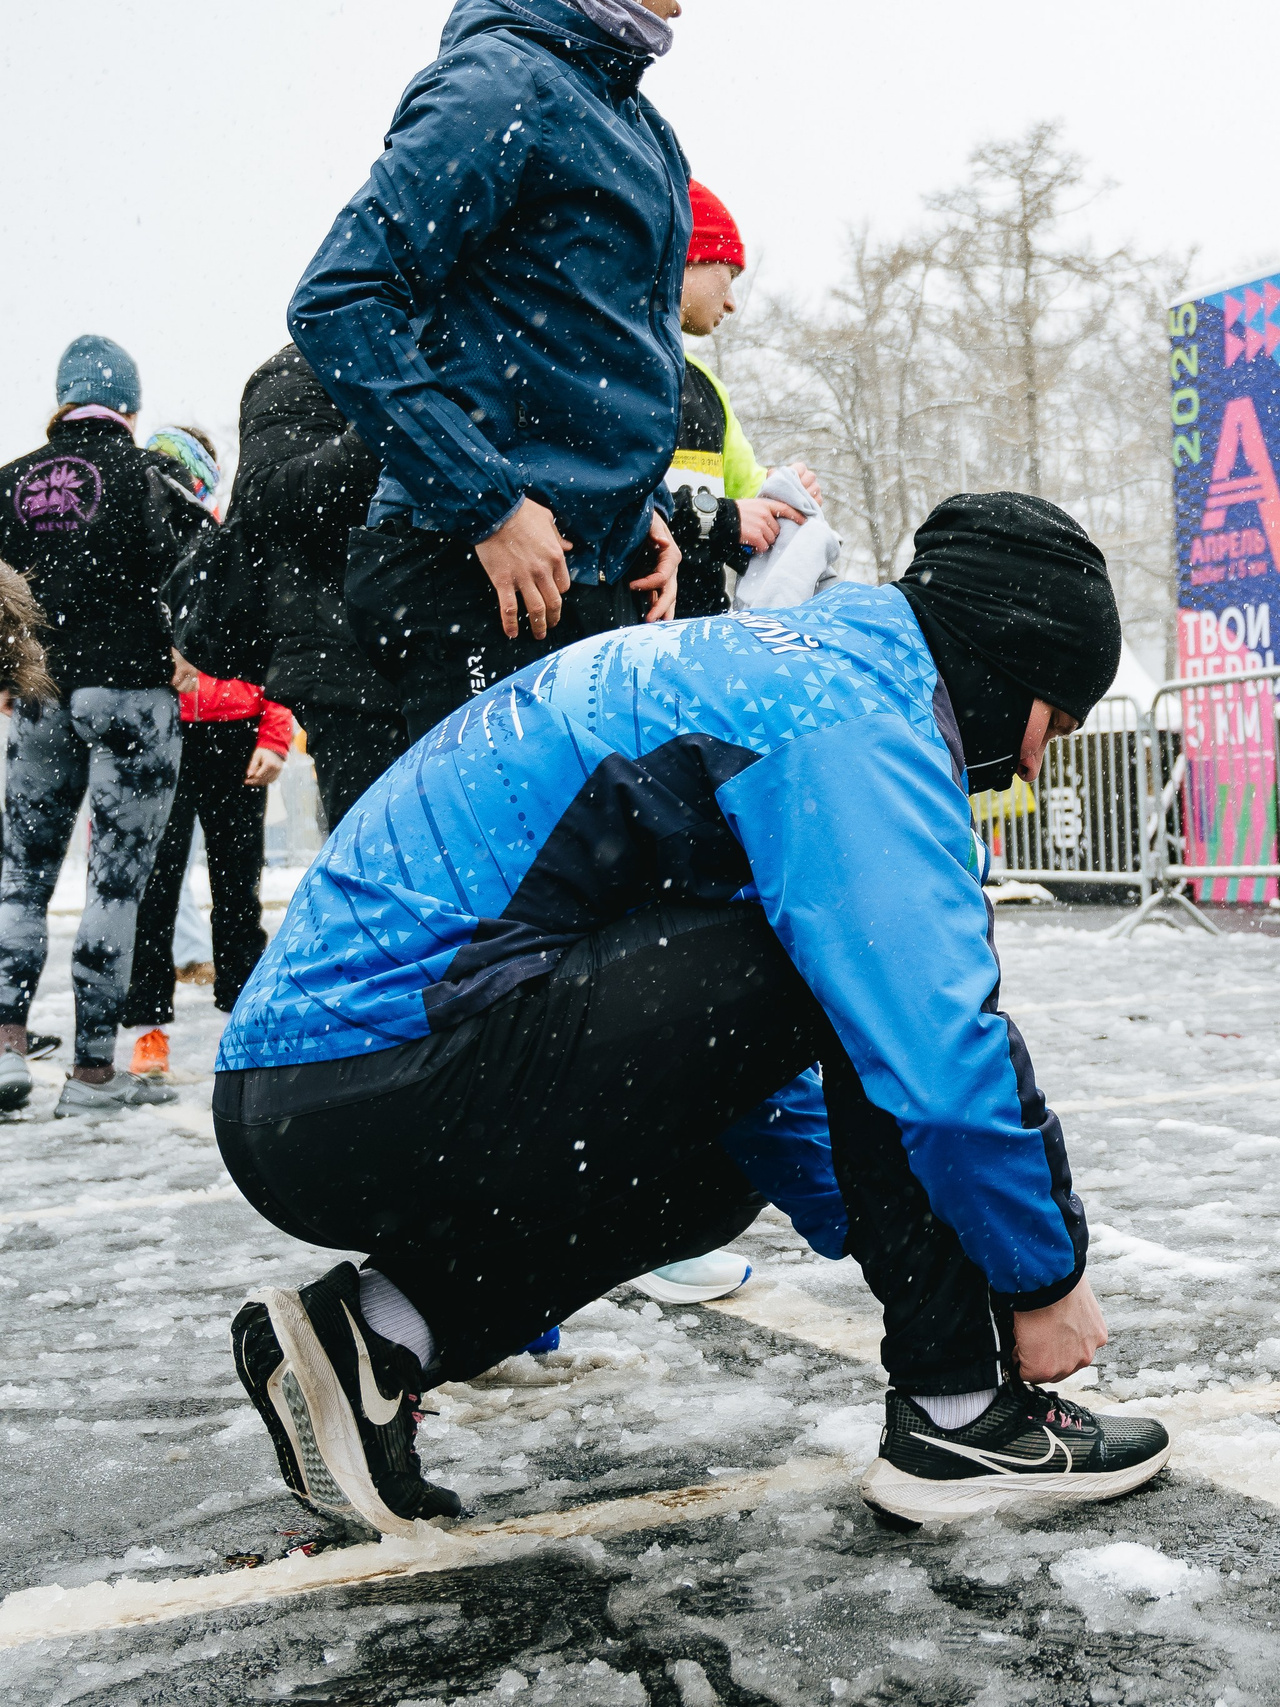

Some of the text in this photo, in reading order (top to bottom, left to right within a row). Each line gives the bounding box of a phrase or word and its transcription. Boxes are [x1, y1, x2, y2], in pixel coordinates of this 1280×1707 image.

[1168, 301, 1201, 468] 2025
[1182, 601, 1271, 656] ТВОИ
[1186, 698, 1262, 749] 5 КМ
